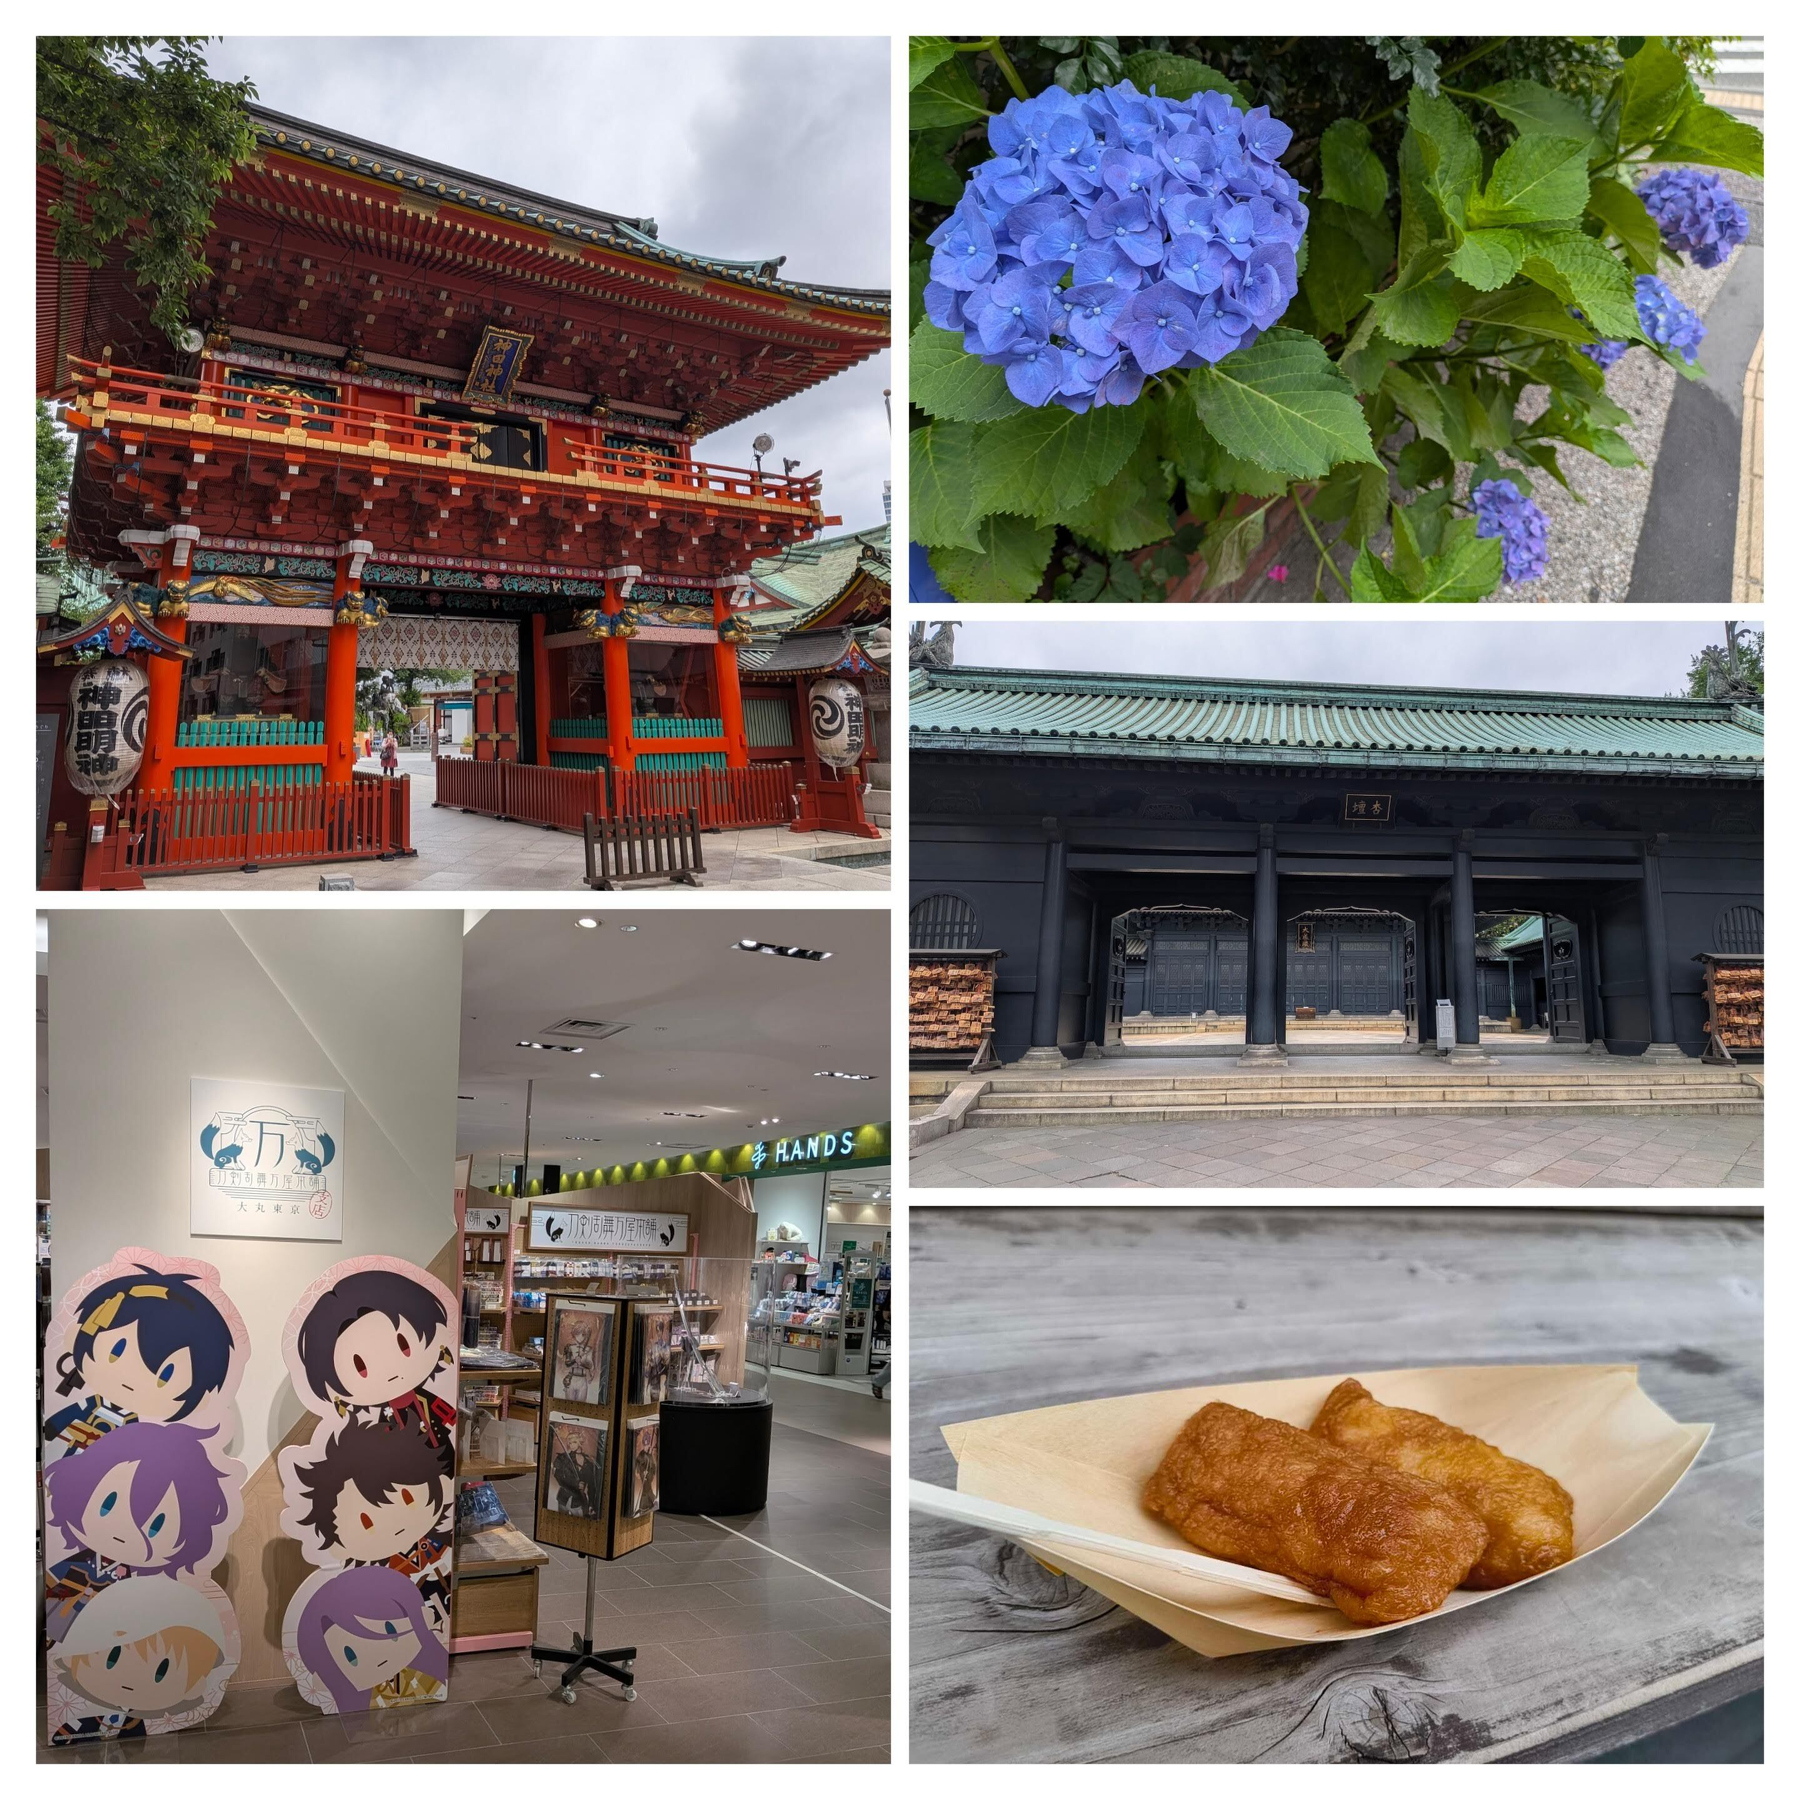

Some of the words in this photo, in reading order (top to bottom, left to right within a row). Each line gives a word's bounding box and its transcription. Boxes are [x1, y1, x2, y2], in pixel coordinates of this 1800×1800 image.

[74, 681, 122, 777] 神田明神
[776, 1131, 853, 1163] HANDS
[237, 1201, 301, 1216] 大丸東京
